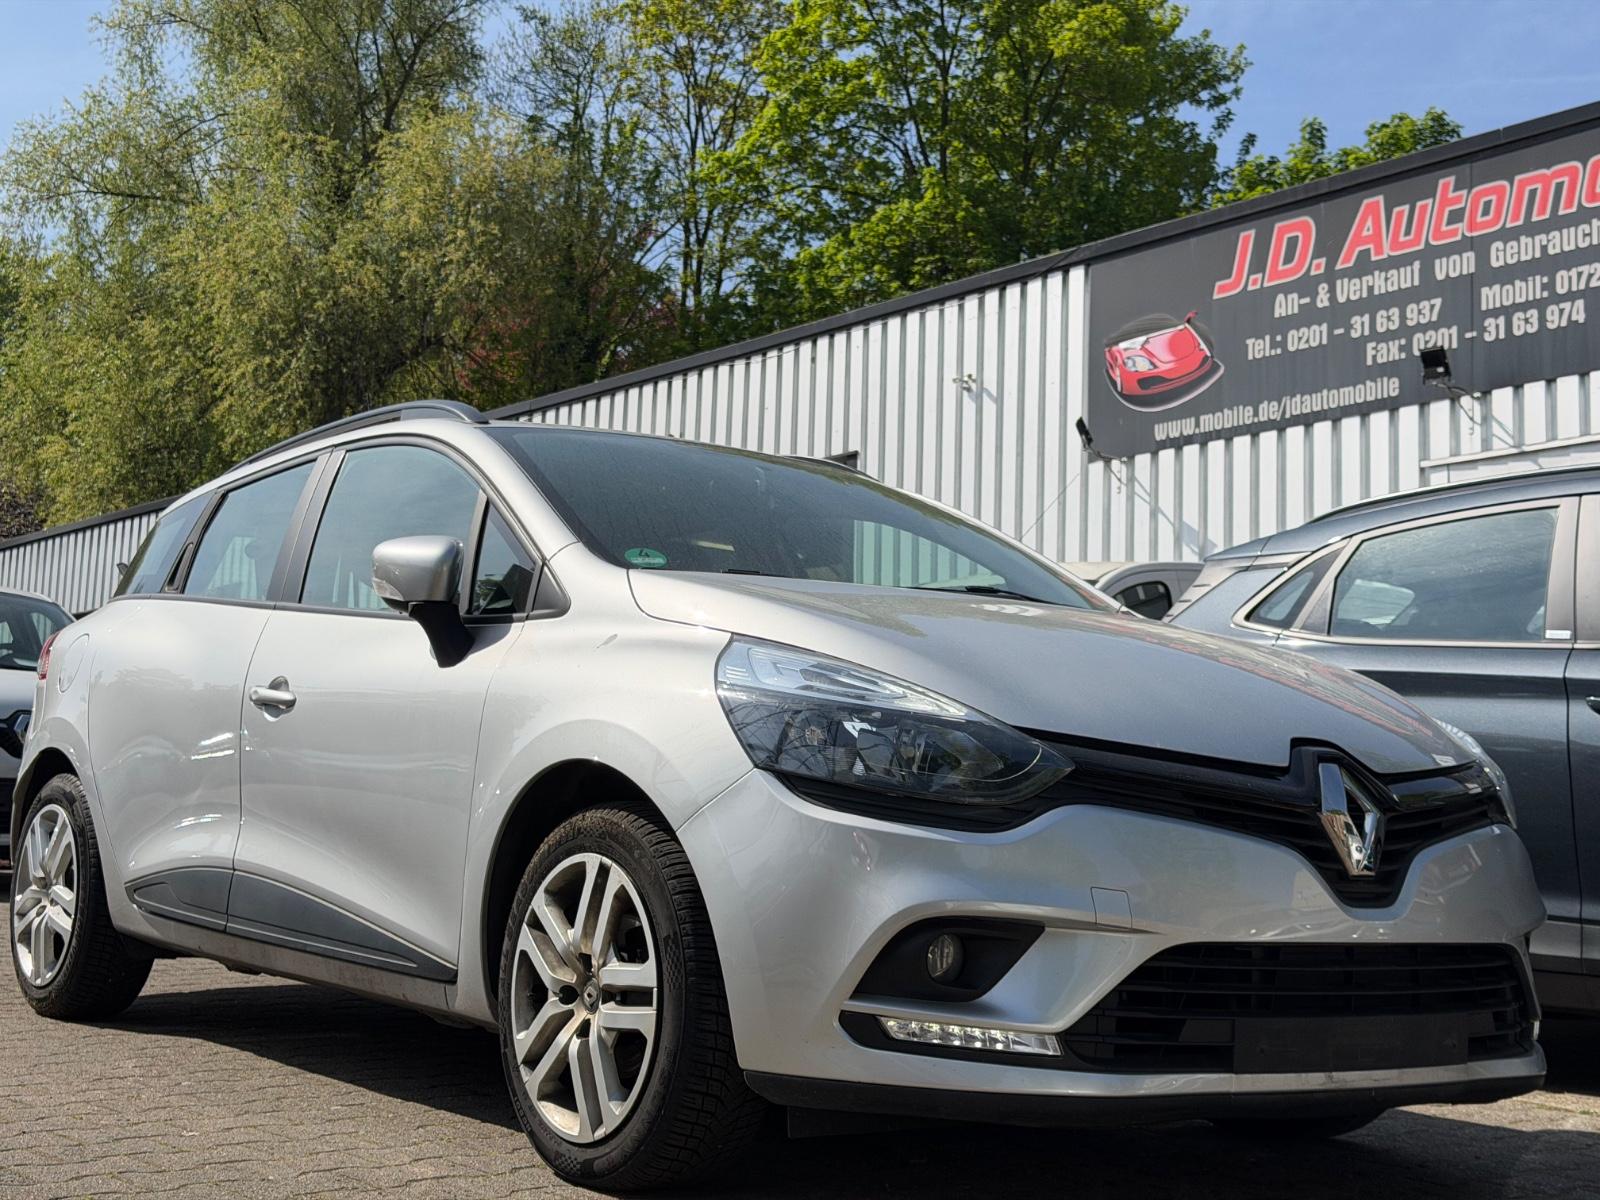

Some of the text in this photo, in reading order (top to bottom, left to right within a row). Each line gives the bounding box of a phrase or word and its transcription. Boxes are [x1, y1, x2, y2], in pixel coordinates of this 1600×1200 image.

[1213, 216, 1327, 299] J.D.
[1274, 292, 1311, 318] An-
[1316, 282, 1330, 308] &
[1336, 261, 1421, 303] Verkauf
[1434, 251, 1476, 281] von
[1246, 334, 1282, 360] Tel.:
[1287, 322, 1328, 352] 0201
[1350, 313, 1370, 338] 31
[1376, 307, 1400, 333] 63
[1406, 297, 1443, 327] 937
[1481, 275, 1549, 311] Mobil:
[1555, 262, 1600, 295] 0172
[1366, 338, 1406, 366] Fax:
[1483, 315, 1505, 342] 31
[1512, 308, 1539, 337] 63
[1546, 299, 1586, 329] 974
[1154, 377, 1400, 441] www.mobile.de/jdautomobile
